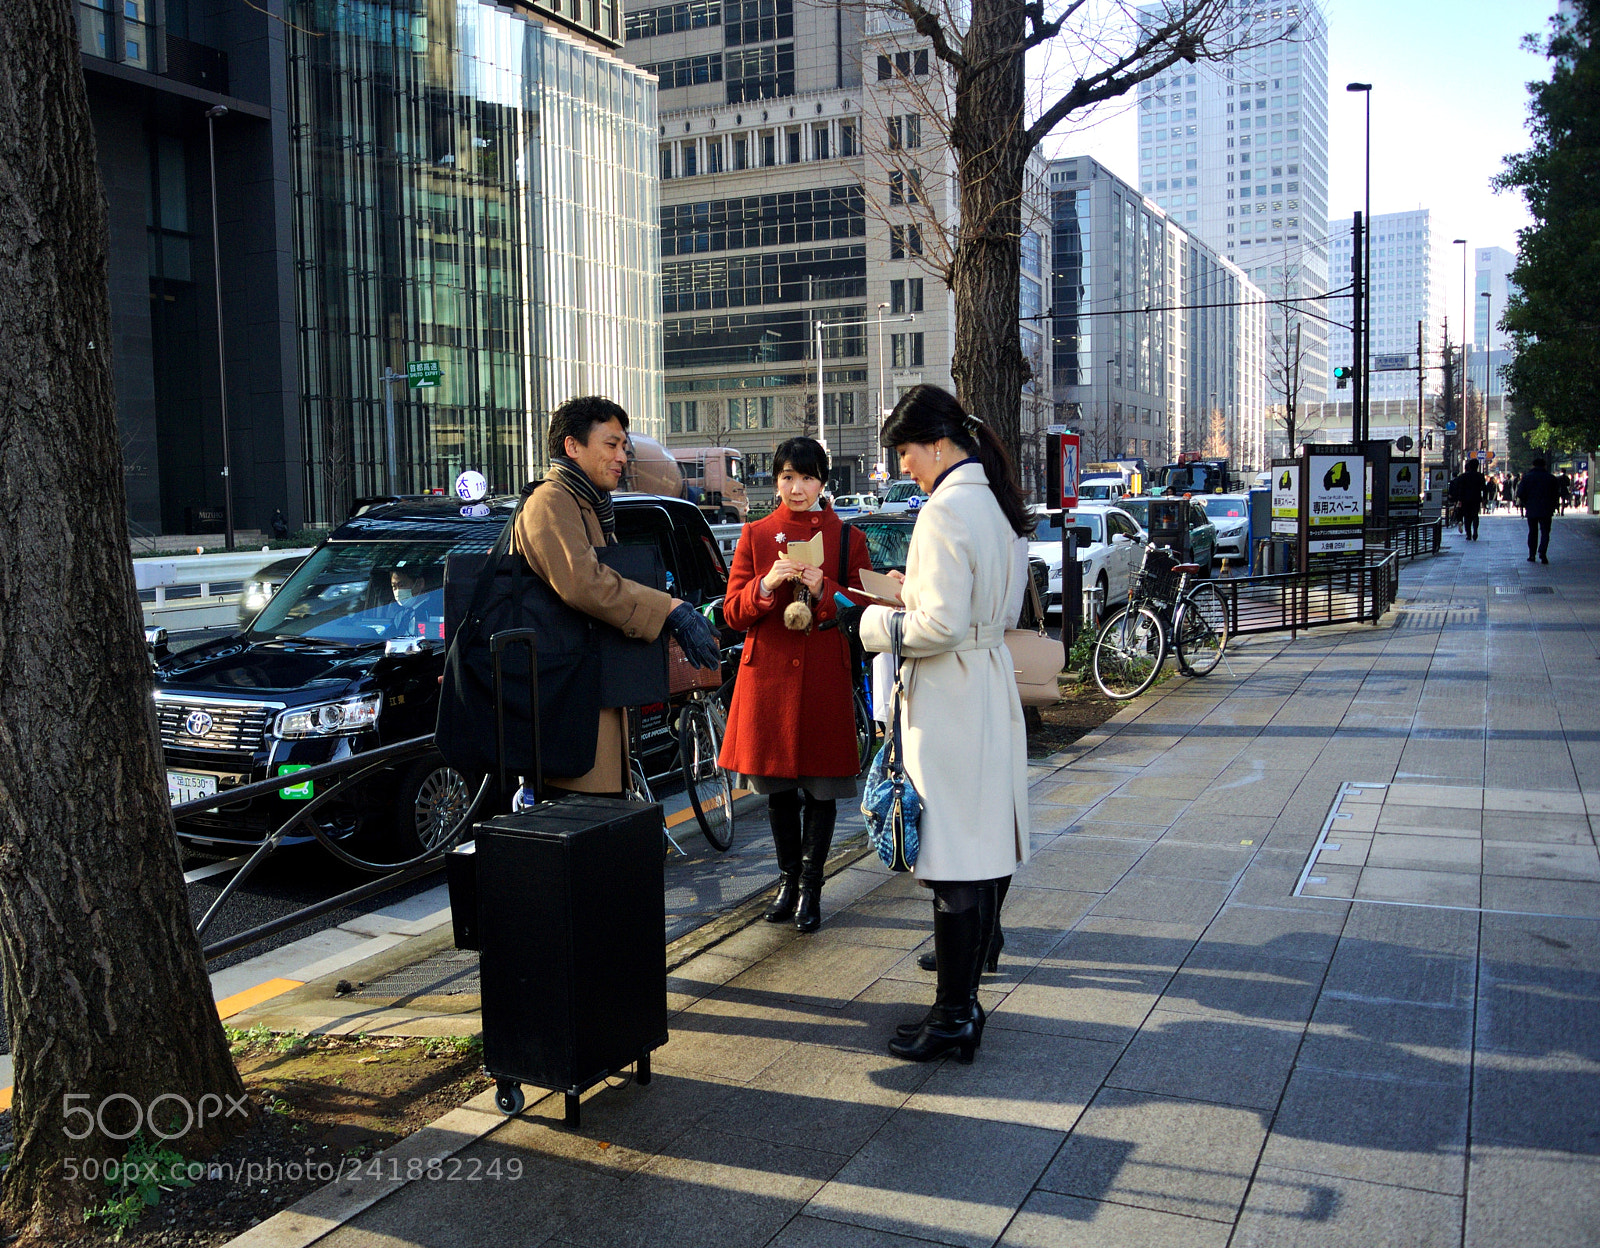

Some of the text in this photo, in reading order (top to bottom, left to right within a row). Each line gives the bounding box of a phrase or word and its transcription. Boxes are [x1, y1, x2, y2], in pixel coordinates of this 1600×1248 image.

[410, 362, 437, 372] 首都高速
[458, 477, 471, 498] 大和
[1313, 501, 1359, 514] 専用スペース
[199, 511, 223, 519] MIZUHO
[641, 702, 664, 715] TOYOTA
